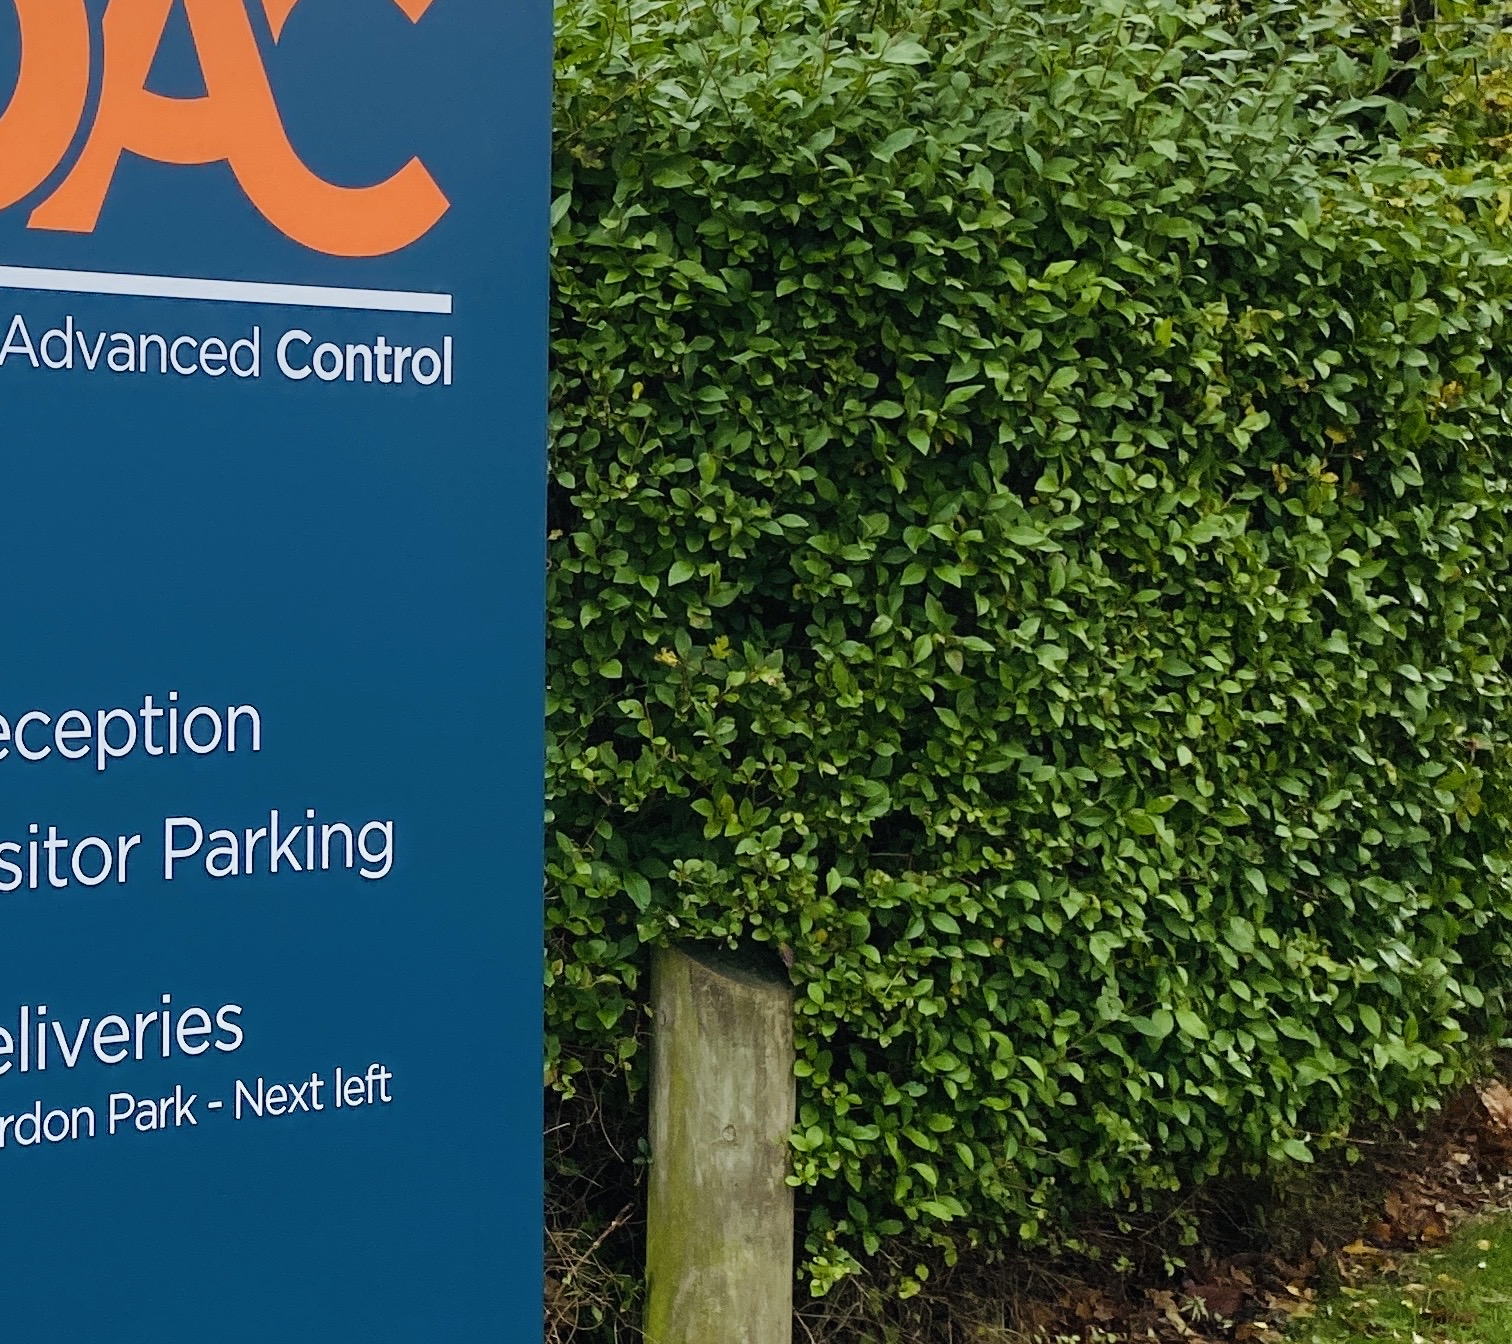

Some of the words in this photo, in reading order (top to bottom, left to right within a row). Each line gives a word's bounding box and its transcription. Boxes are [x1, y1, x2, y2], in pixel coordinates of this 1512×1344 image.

[277, 330, 451, 384] Control
[165, 810, 392, 879] Parking
[110, 1085, 197, 1134] Park
[236, 1073, 324, 1119] Next
[336, 1064, 392, 1107] left
